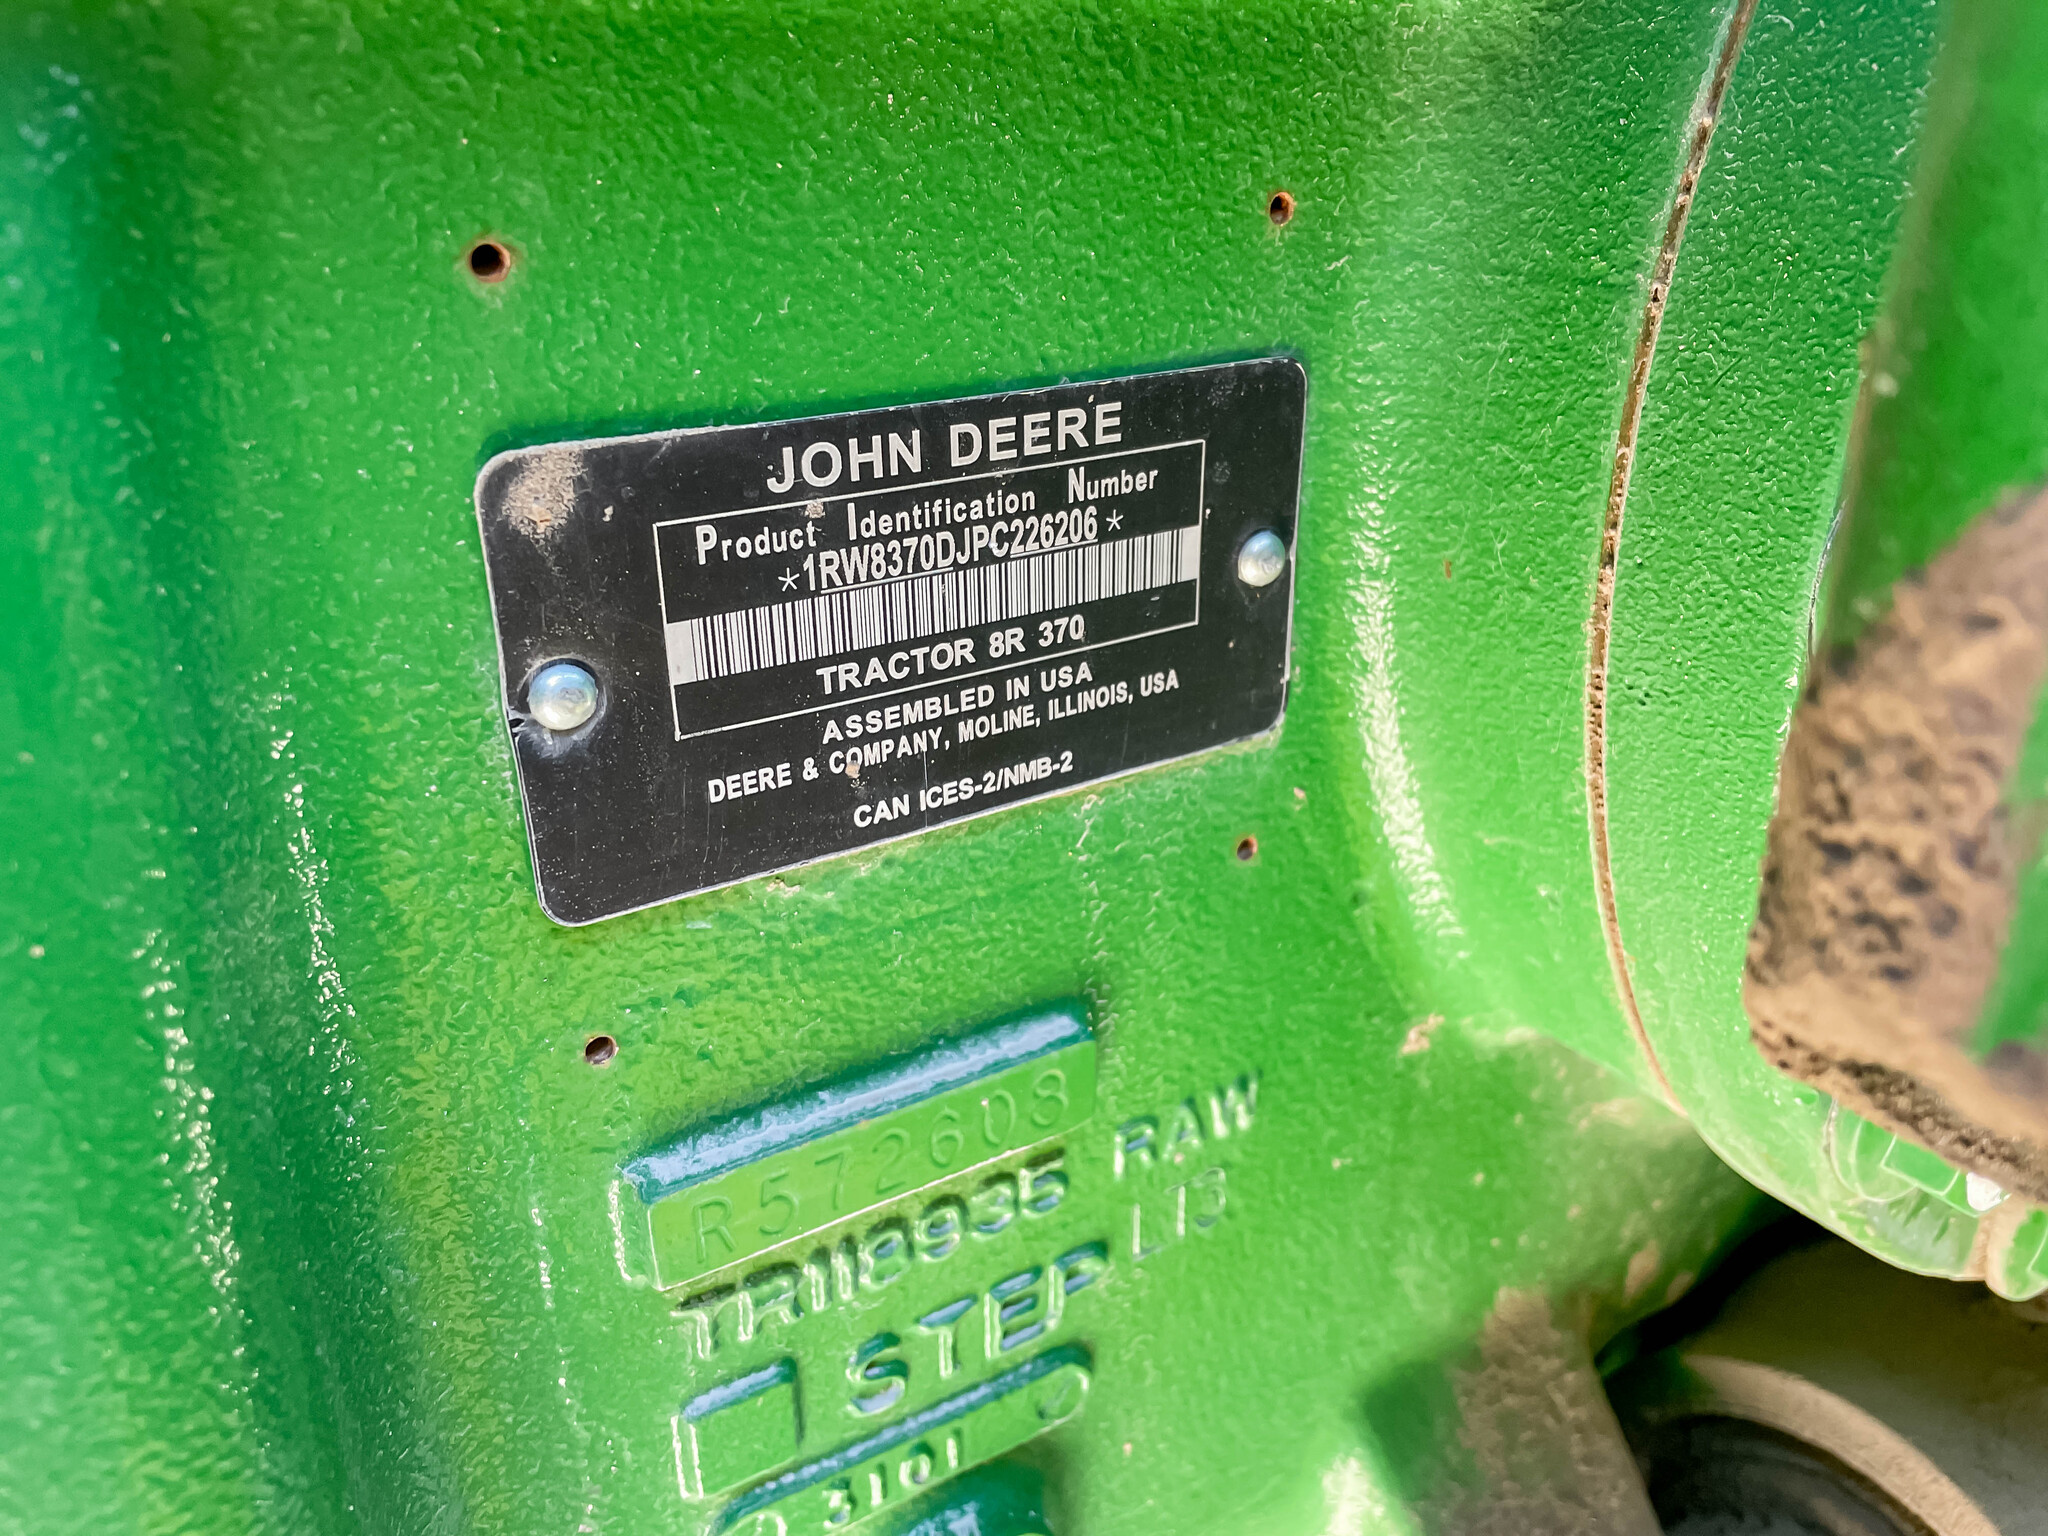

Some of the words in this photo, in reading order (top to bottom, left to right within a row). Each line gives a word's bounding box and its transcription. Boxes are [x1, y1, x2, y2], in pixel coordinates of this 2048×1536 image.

[767, 429, 922, 494] JOHN
[950, 401, 1122, 468] DEERE
[695, 520, 817, 566] Product
[847, 490, 1036, 541] Identification
[1067, 466, 1158, 504] Number
[816, 638, 976, 695] TRACTOR
[989, 627, 1026, 659] 8R
[1038, 614, 1085, 648] 370
[822, 684, 995, 745] ASSEMBLED
[1006, 675, 1030, 702] IN
[1040, 661, 1093, 693] USA
[708, 762, 793, 804] DEERE
[802, 757, 819, 782] &
[829, 726, 950, 775] COMPANY,
[958, 704, 1041, 744] MOLINE,
[1048, 681, 1134, 721] ILLINOIS,
[1140, 668, 1180, 698] USA
[853, 794, 910, 828] CAN
[919, 750, 1074, 812] ICES-2/NMB-2
[690, 1068, 1070, 1265] R572608
[1112, 1068, 1263, 1183] RAW
[844, 1240, 1109, 1418] STEP
